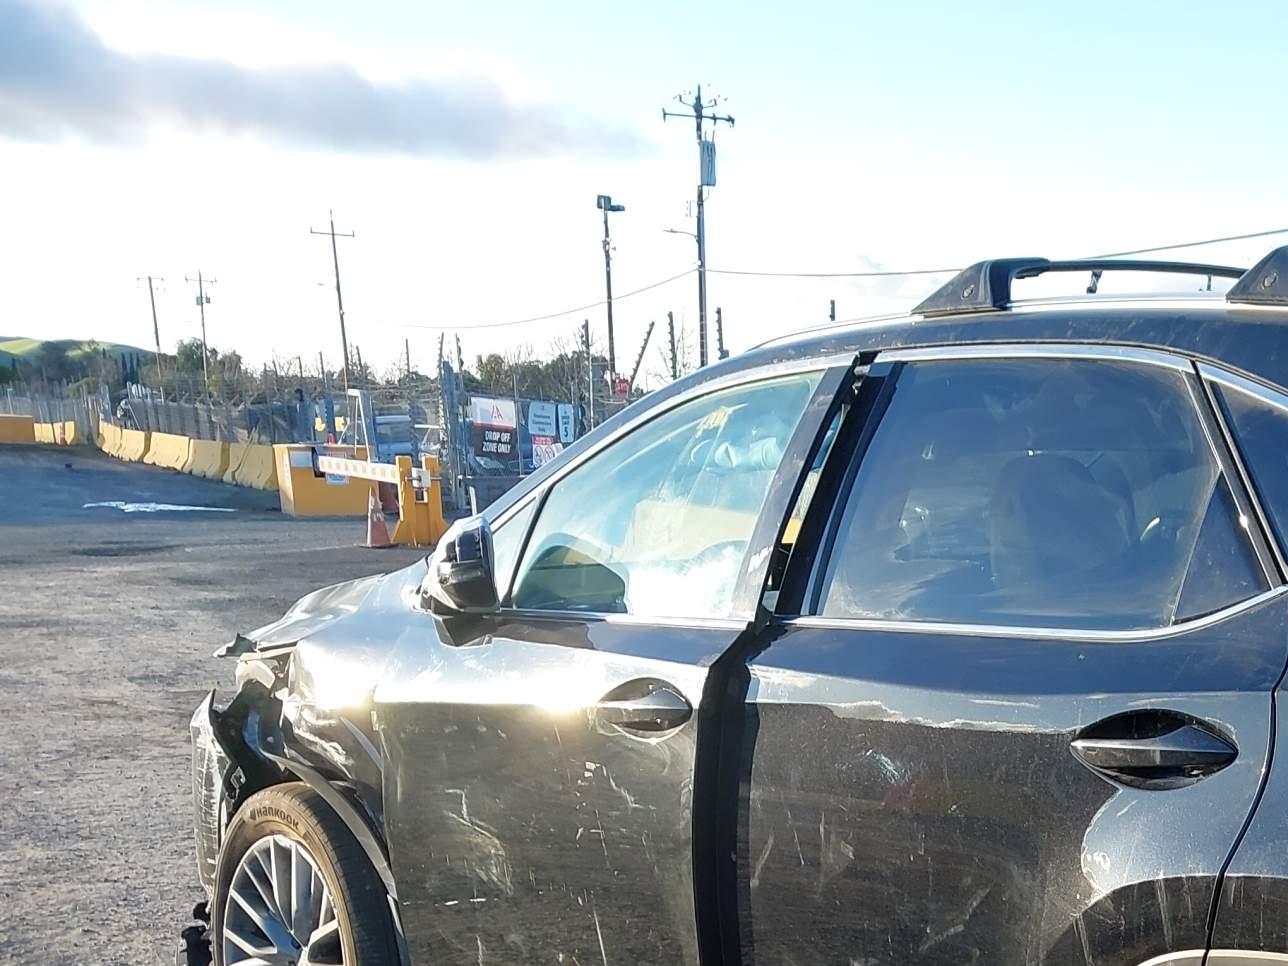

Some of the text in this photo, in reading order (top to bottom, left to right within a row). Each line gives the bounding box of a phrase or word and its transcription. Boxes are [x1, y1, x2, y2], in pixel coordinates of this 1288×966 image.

[485, 430, 511, 443] DROP OFF
[563, 426, 570, 438] 5
[482, 441, 512, 454] ZONE ONLY
